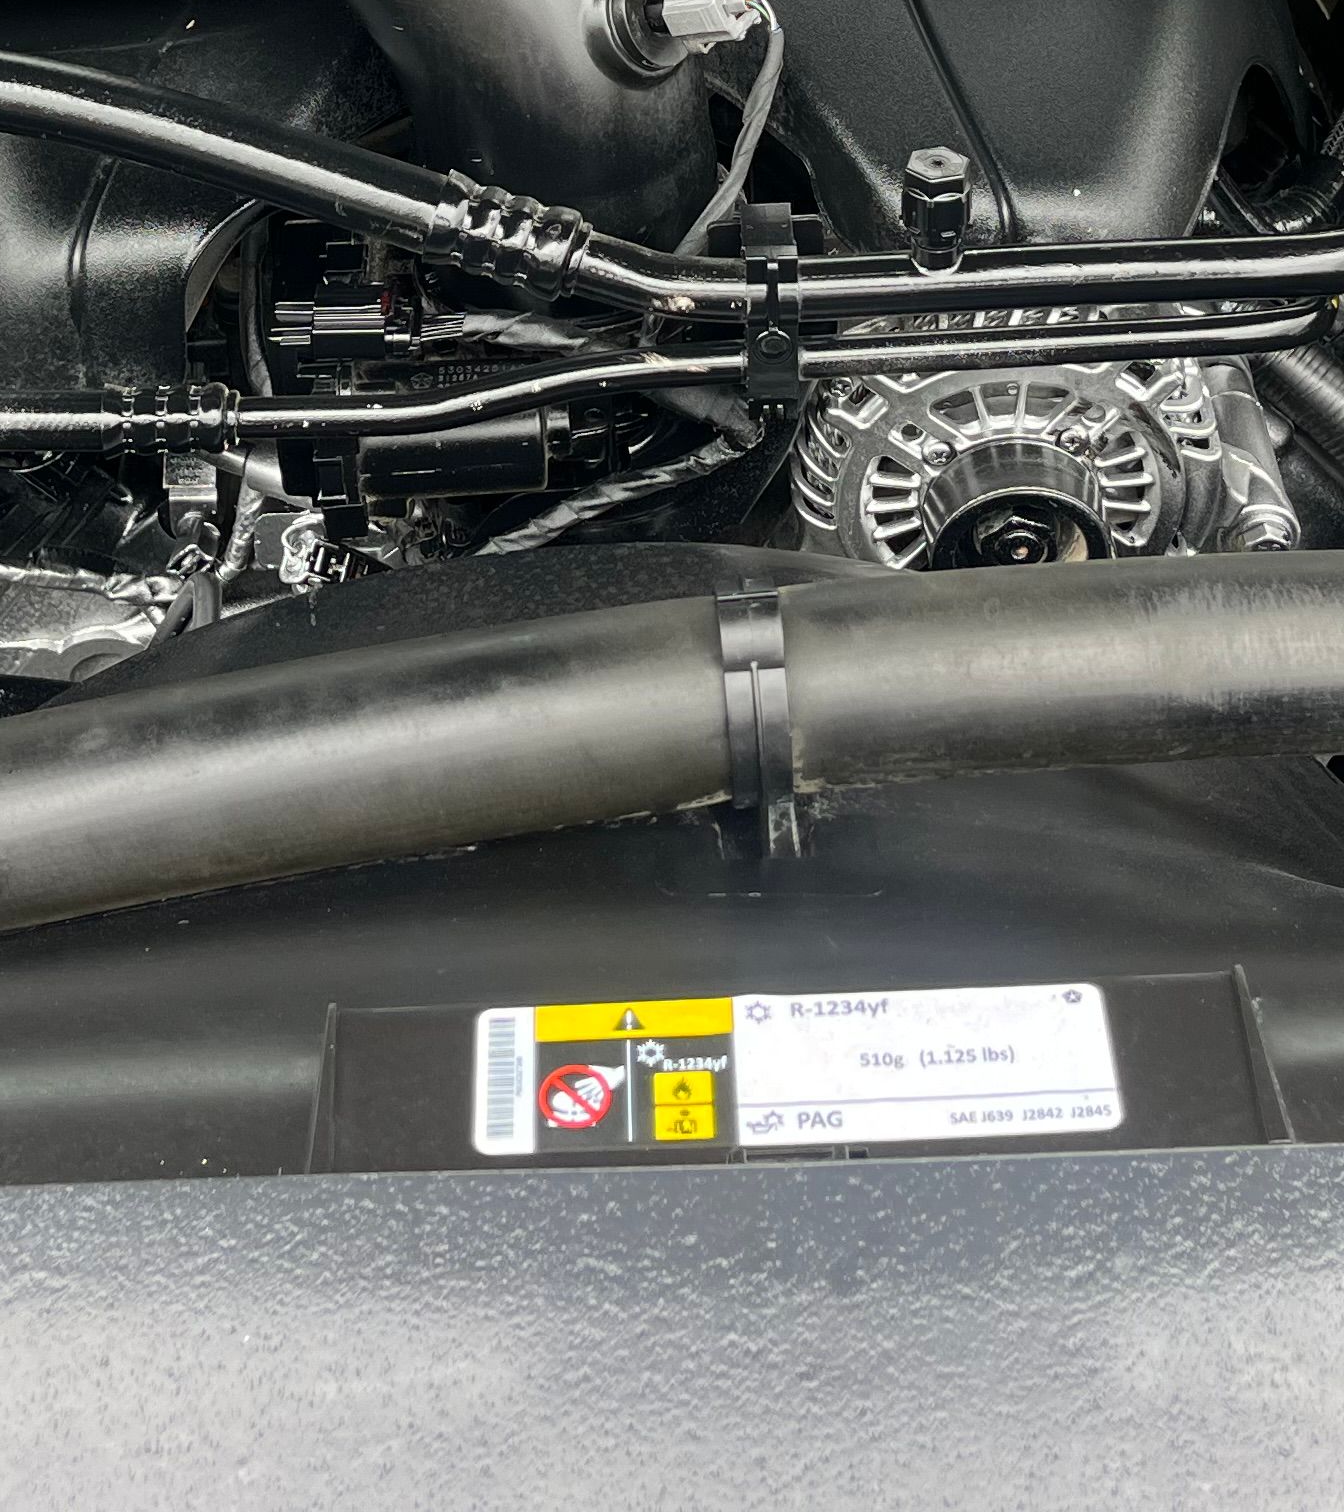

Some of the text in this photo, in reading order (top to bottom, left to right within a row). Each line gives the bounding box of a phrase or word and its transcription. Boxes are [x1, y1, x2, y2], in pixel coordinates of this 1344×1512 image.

[790, 998, 890, 1018] R-1234yf
[663, 1054, 728, 1072] R-1234yf
[859, 1045, 1016, 1069] 510g (1.125 lbs)
[797, 1110, 844, 1130] PAG
[949, 1104, 1113, 1125] SAE J639 J2842 J2845
